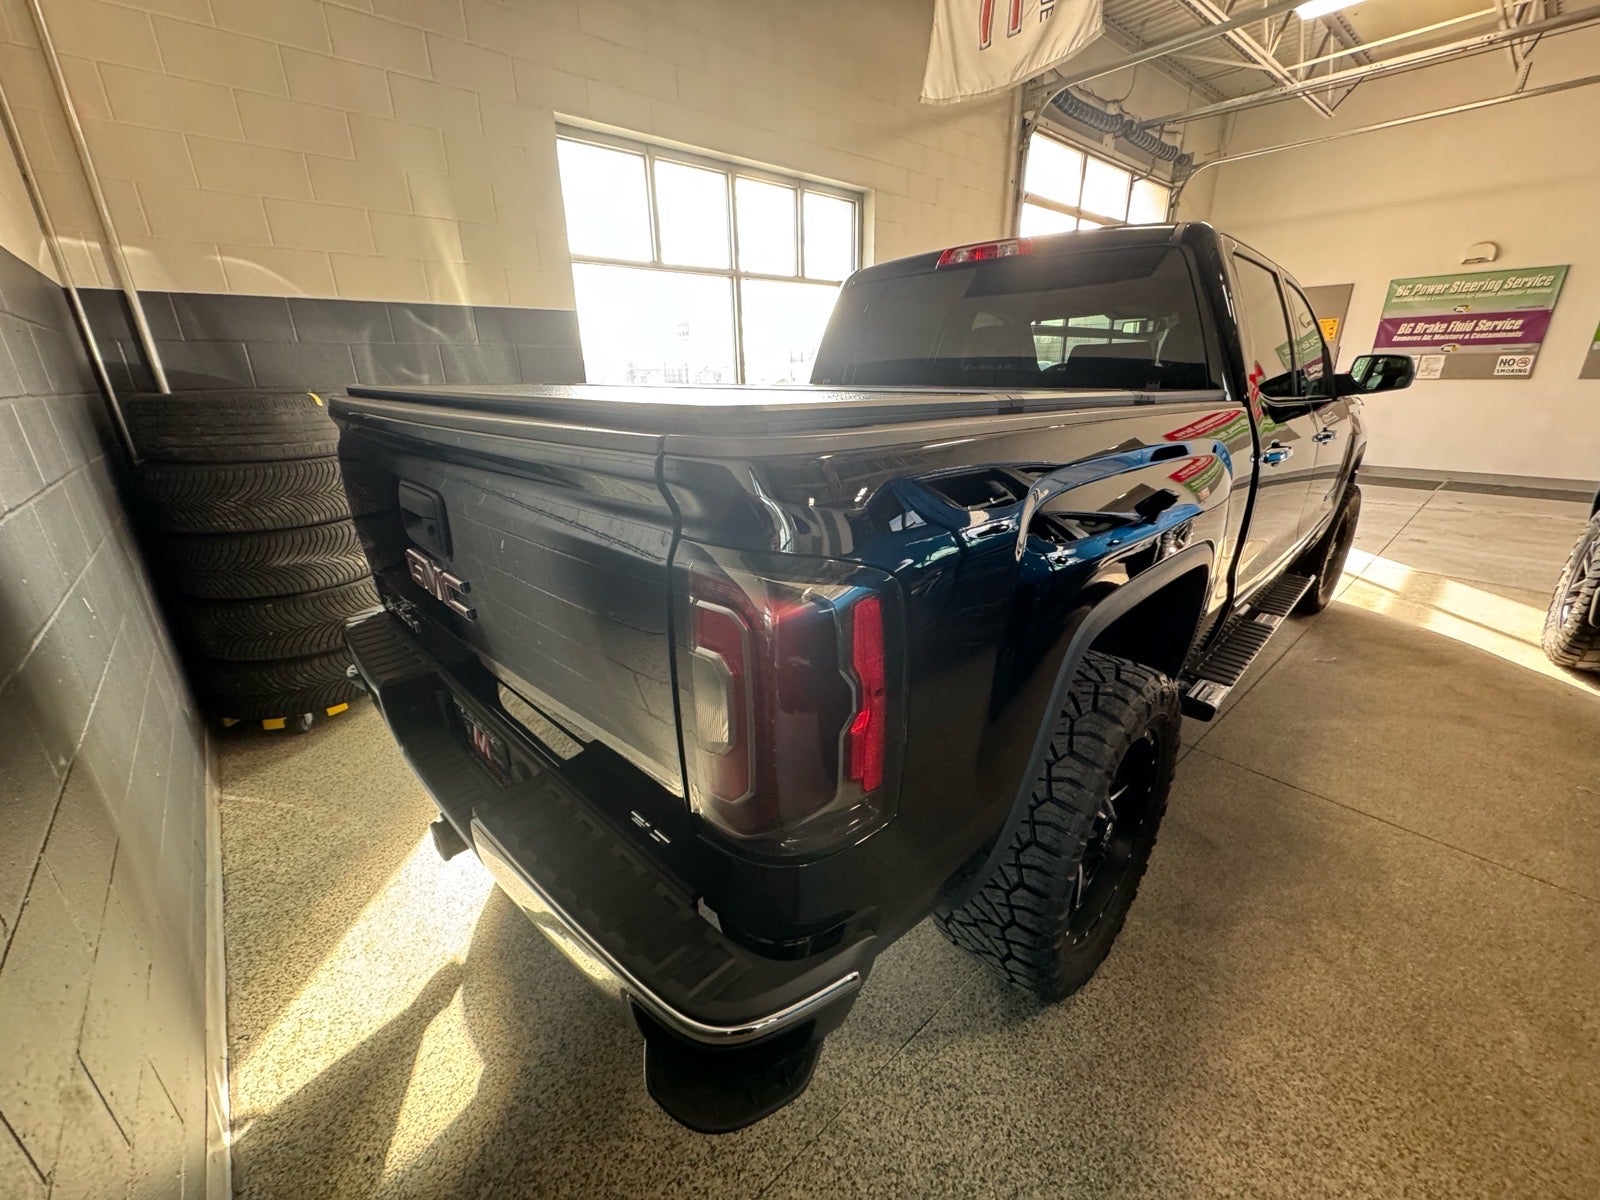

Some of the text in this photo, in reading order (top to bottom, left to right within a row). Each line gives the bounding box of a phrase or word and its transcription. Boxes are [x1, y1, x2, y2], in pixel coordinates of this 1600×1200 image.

[1395, 285, 1413, 297] BG
[1412, 284, 1449, 296] Power
[1450, 280, 1503, 295] Steering
[1503, 275, 1555, 290] Service
[1397, 318, 1524, 334] BG Brake Fluid Service
[1471, 331, 1524, 339] Contaminants
[1499, 358, 1516, 367] NO
[405, 548, 477, 623] GMC
